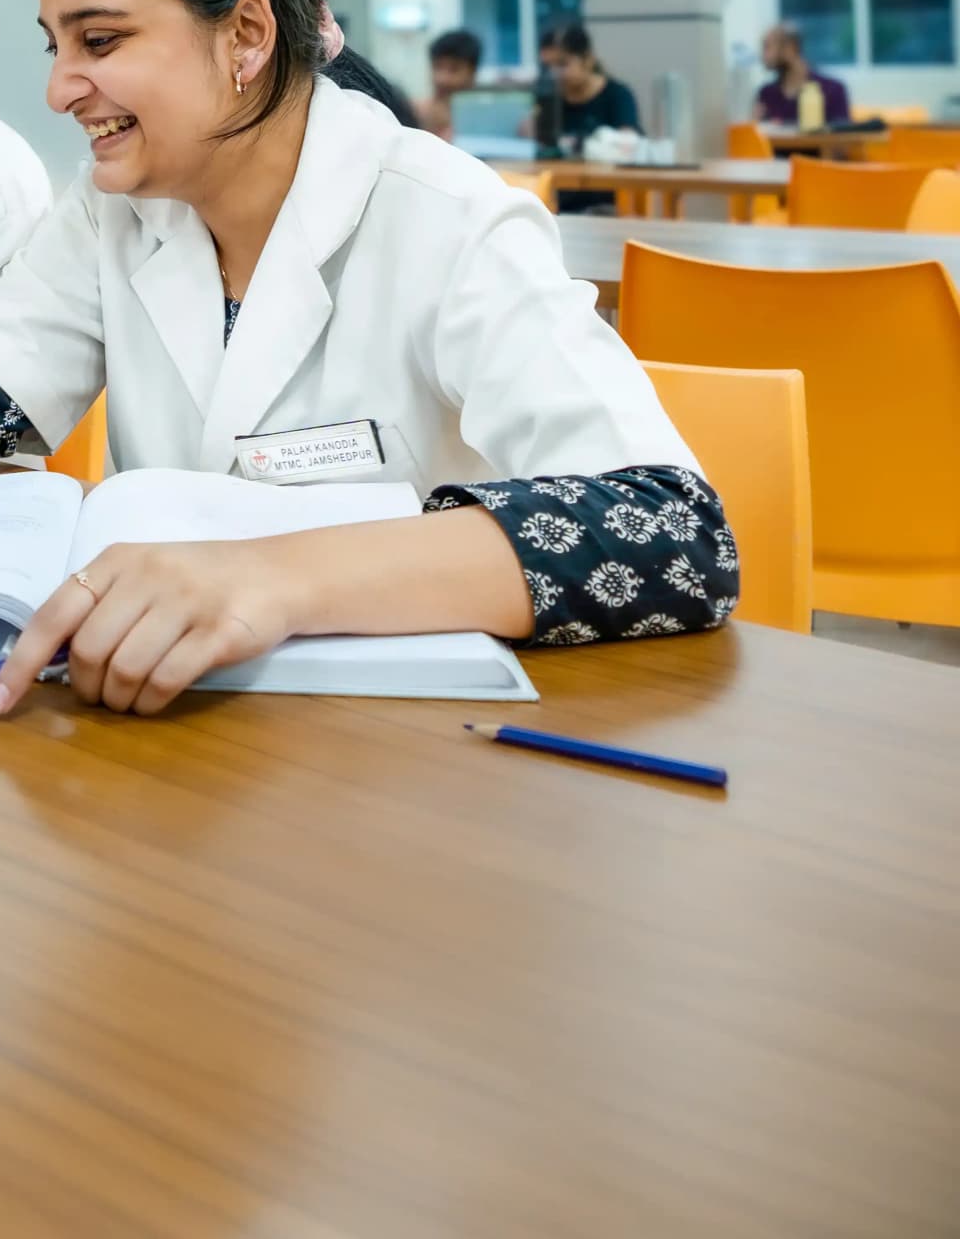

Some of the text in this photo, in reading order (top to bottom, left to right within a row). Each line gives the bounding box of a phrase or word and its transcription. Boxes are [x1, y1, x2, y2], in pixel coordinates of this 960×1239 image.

[280, 438, 358, 457] PALAK KANODIA
[308, 449, 373, 467] JAMSHEDPUR
